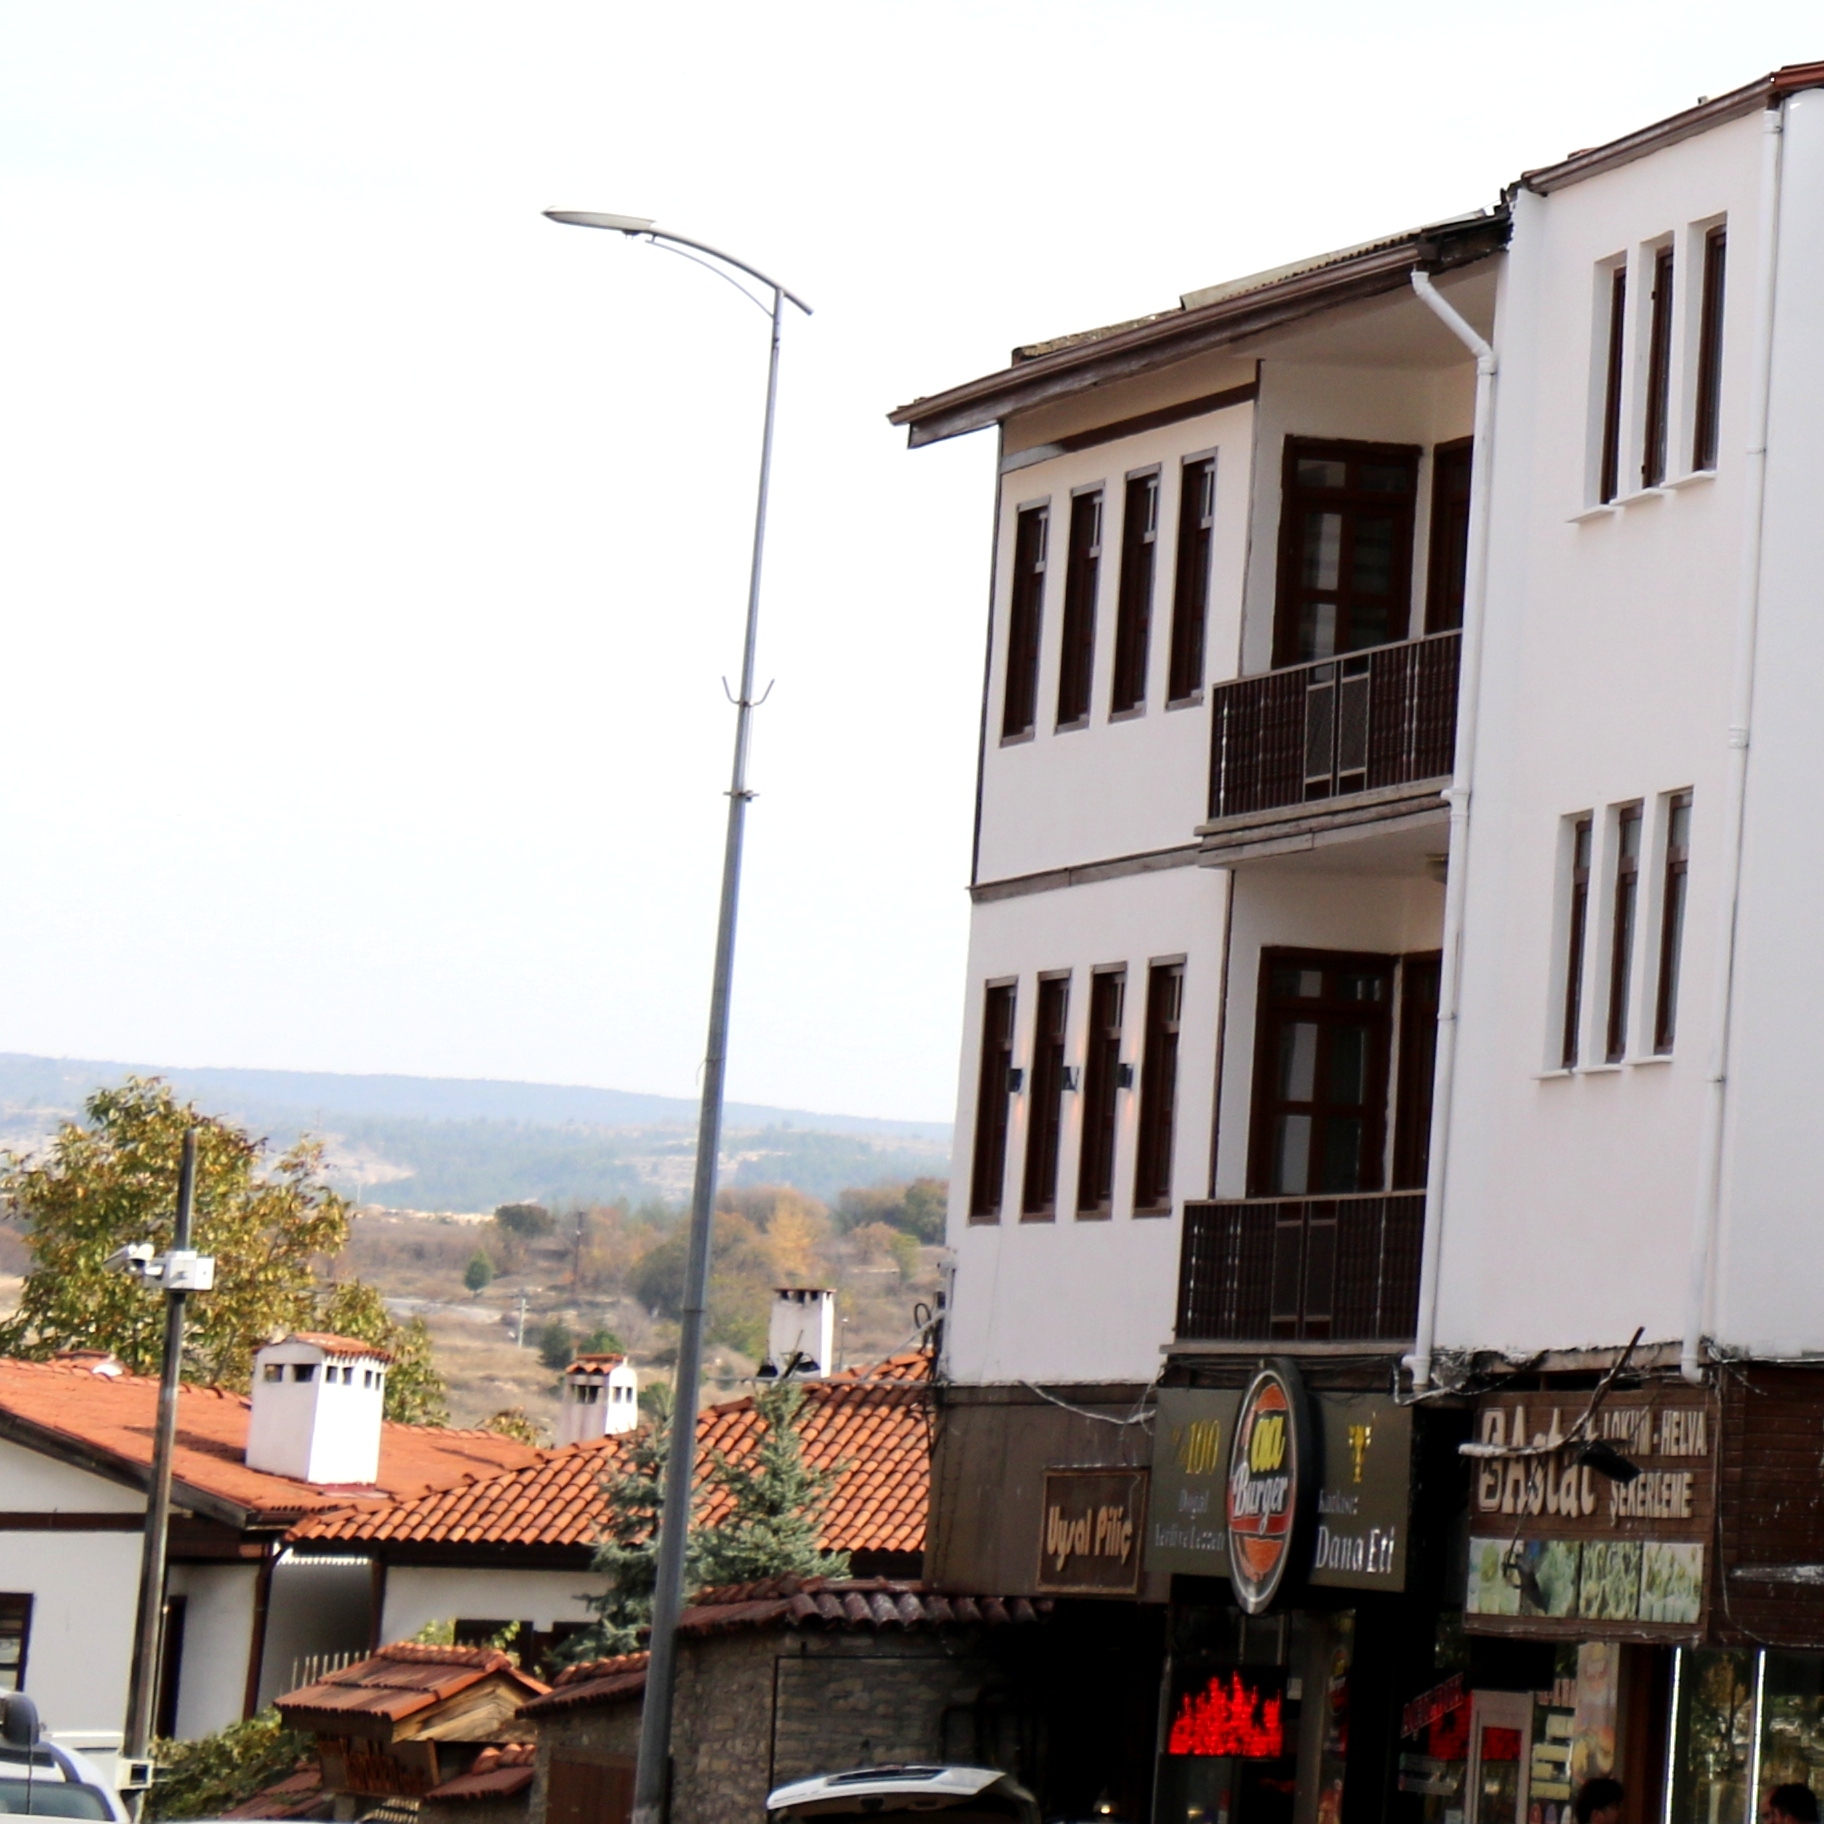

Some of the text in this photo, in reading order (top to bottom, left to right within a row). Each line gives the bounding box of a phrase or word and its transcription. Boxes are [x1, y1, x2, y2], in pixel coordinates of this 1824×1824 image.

[1660, 1409, 1708, 1456] HELVA
[1232, 1461, 1289, 1536] Burger
[1609, 1472, 1694, 1527] ŞEKERLEME
[1046, 1504, 1134, 1573] Uysal Piliç
[1314, 1525, 1396, 1575] Dana Eti
